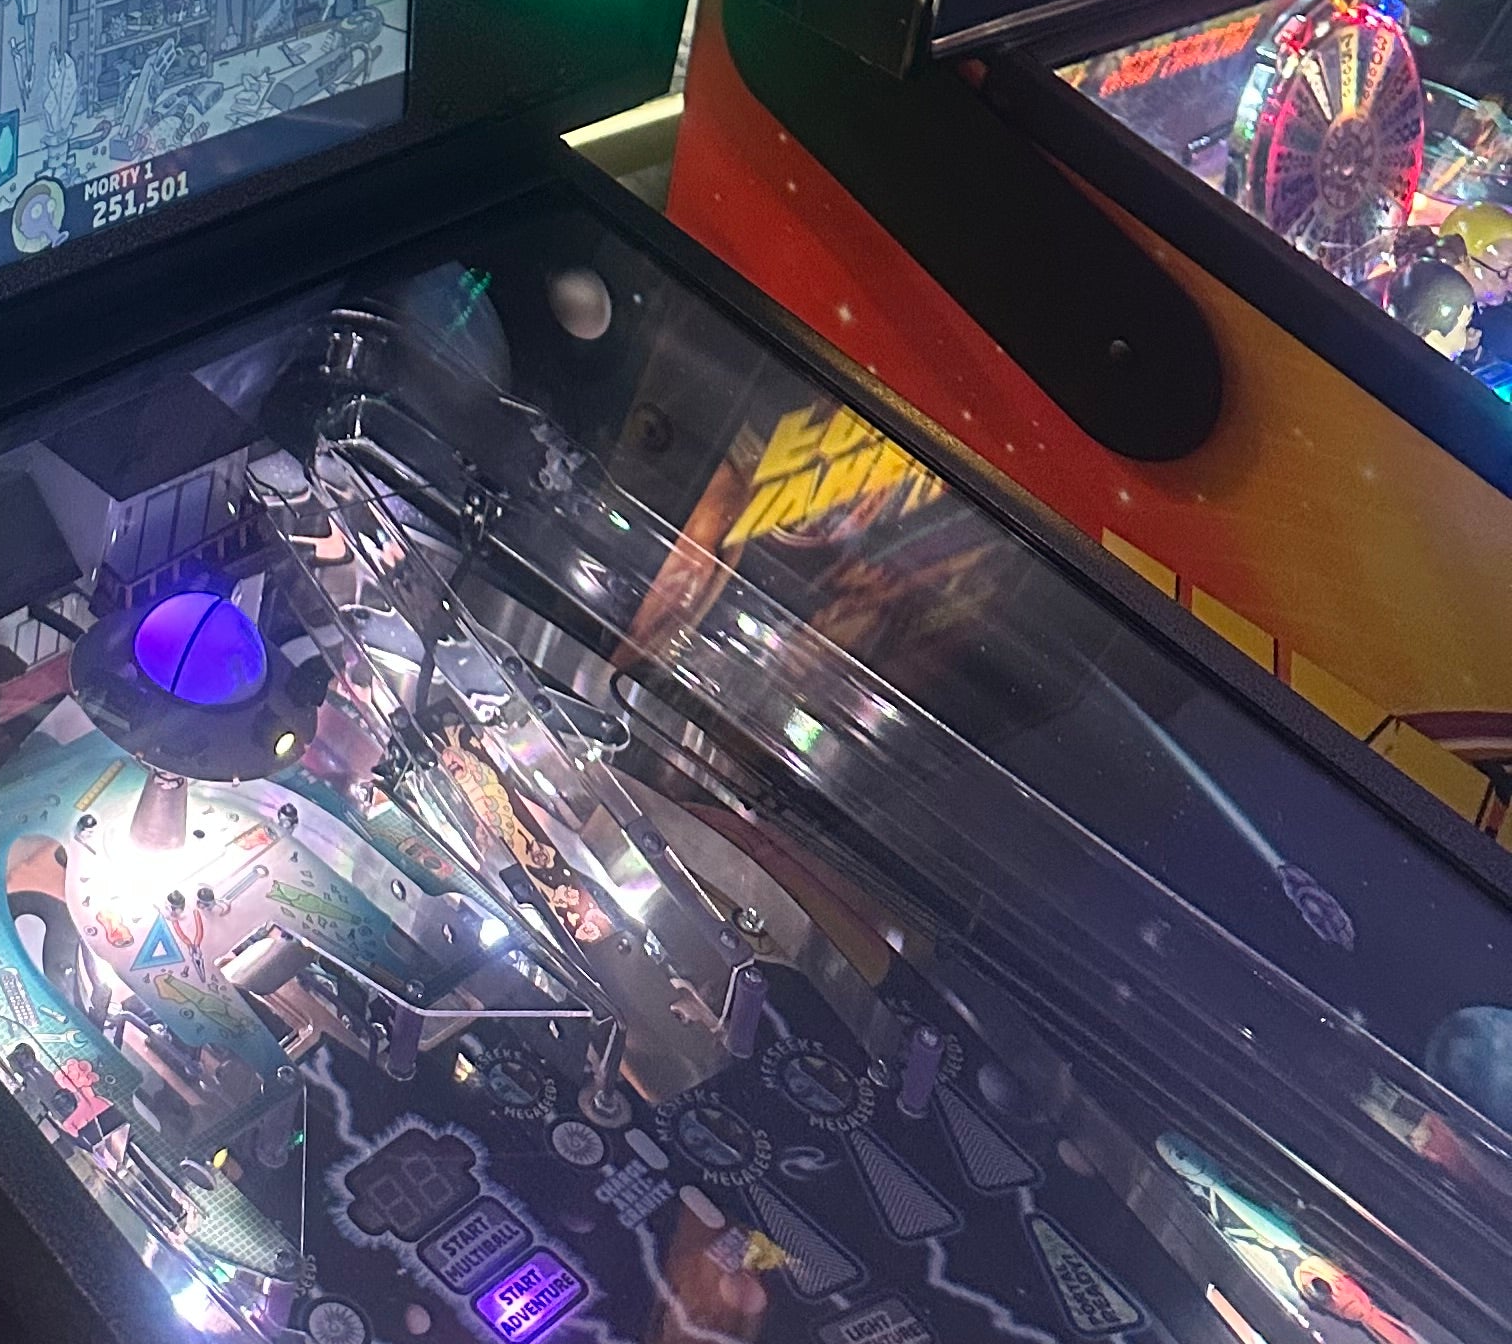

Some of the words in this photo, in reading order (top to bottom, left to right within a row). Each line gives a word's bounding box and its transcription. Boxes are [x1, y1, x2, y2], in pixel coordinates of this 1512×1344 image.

[84, 165, 141, 201] MORTY
[144, 161, 154, 179] 1
[92, 170, 190, 229] 251,501
[504, 1077, 558, 1120] MEGASEEDS
[655, 1086, 723, 1142] MEESEEKS
[808, 1073, 879, 1132] MEGASEEDS
[702, 1128, 775, 1187] MEGASEEDS
[439, 1215, 491, 1257] START
[445, 1222, 521, 1283] MULTIBALL
[499, 1268, 545, 1307] START
[500, 1270, 577, 1338] ADVENTURE
[846, 1313, 892, 1342] LIGHT
